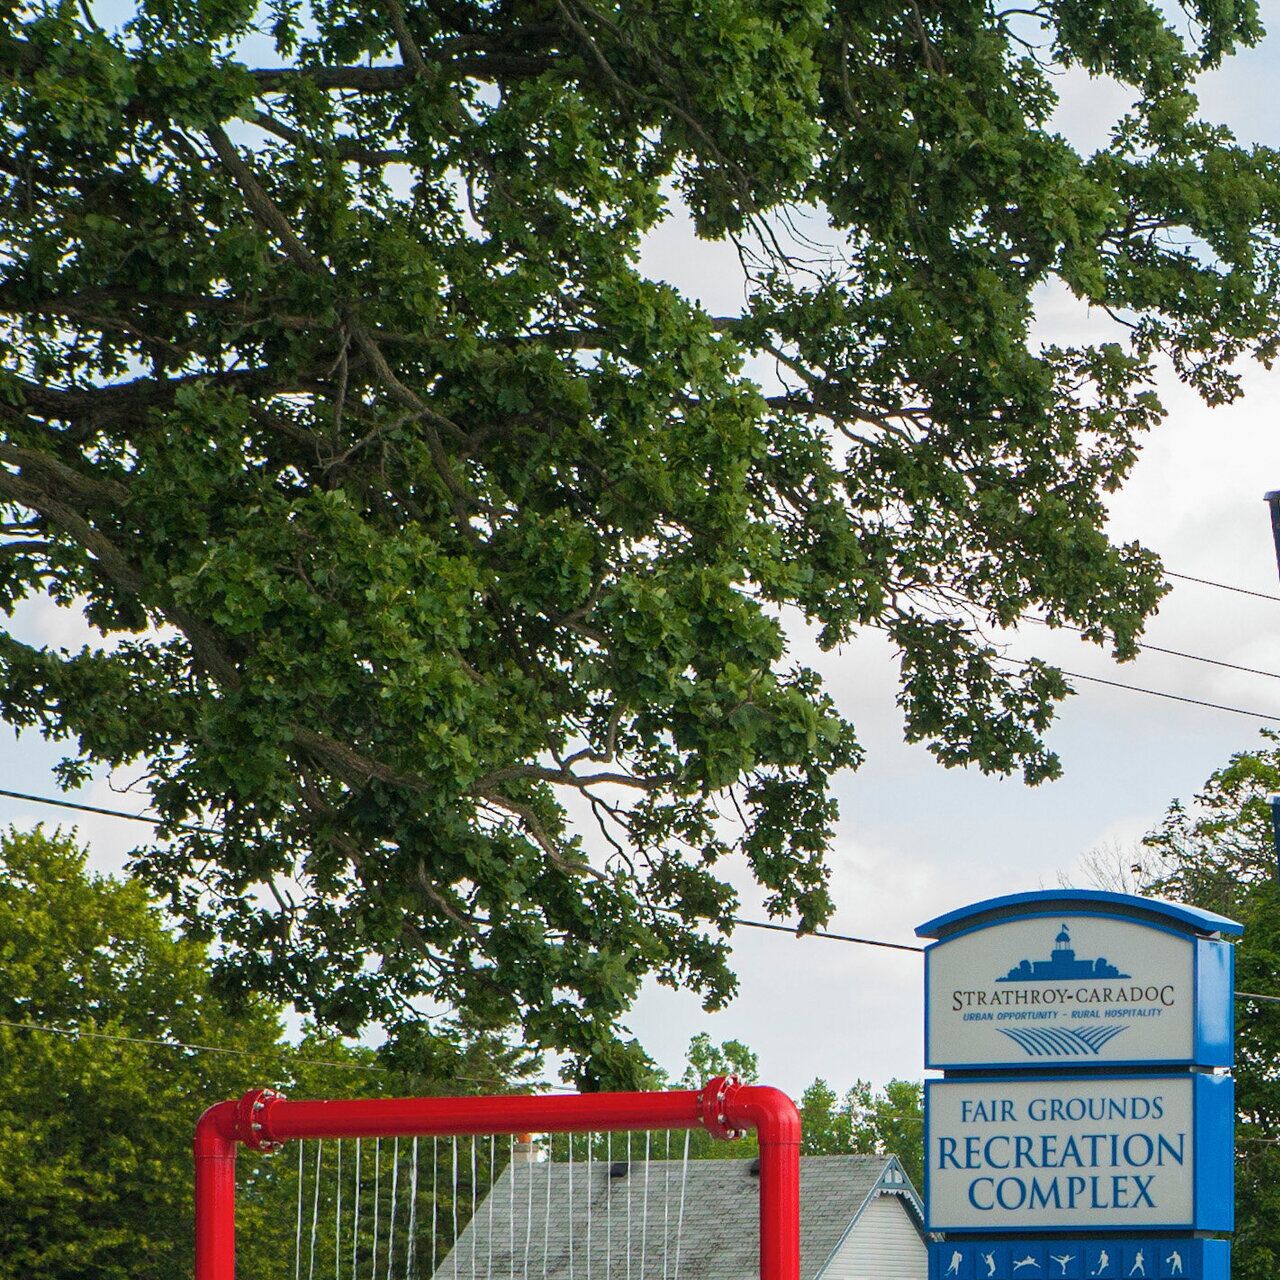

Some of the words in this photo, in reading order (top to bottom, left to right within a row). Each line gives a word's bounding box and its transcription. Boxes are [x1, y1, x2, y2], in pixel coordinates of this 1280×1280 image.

[952, 985, 1175, 1011] STRATHROY-CARADOC
[963, 1012, 994, 1021] URBAN
[997, 1010, 1060, 1020] OPPORTUNITY
[1071, 1009, 1100, 1019] RURAL
[1104, 1007, 1163, 1018] HOSPITALITY
[961, 1099, 1018, 1122] FAIR
[1028, 1096, 1164, 1121] GROUNDS
[937, 1133, 1187, 1169] RECREATION
[968, 1175, 1160, 1210] COMPLEX
